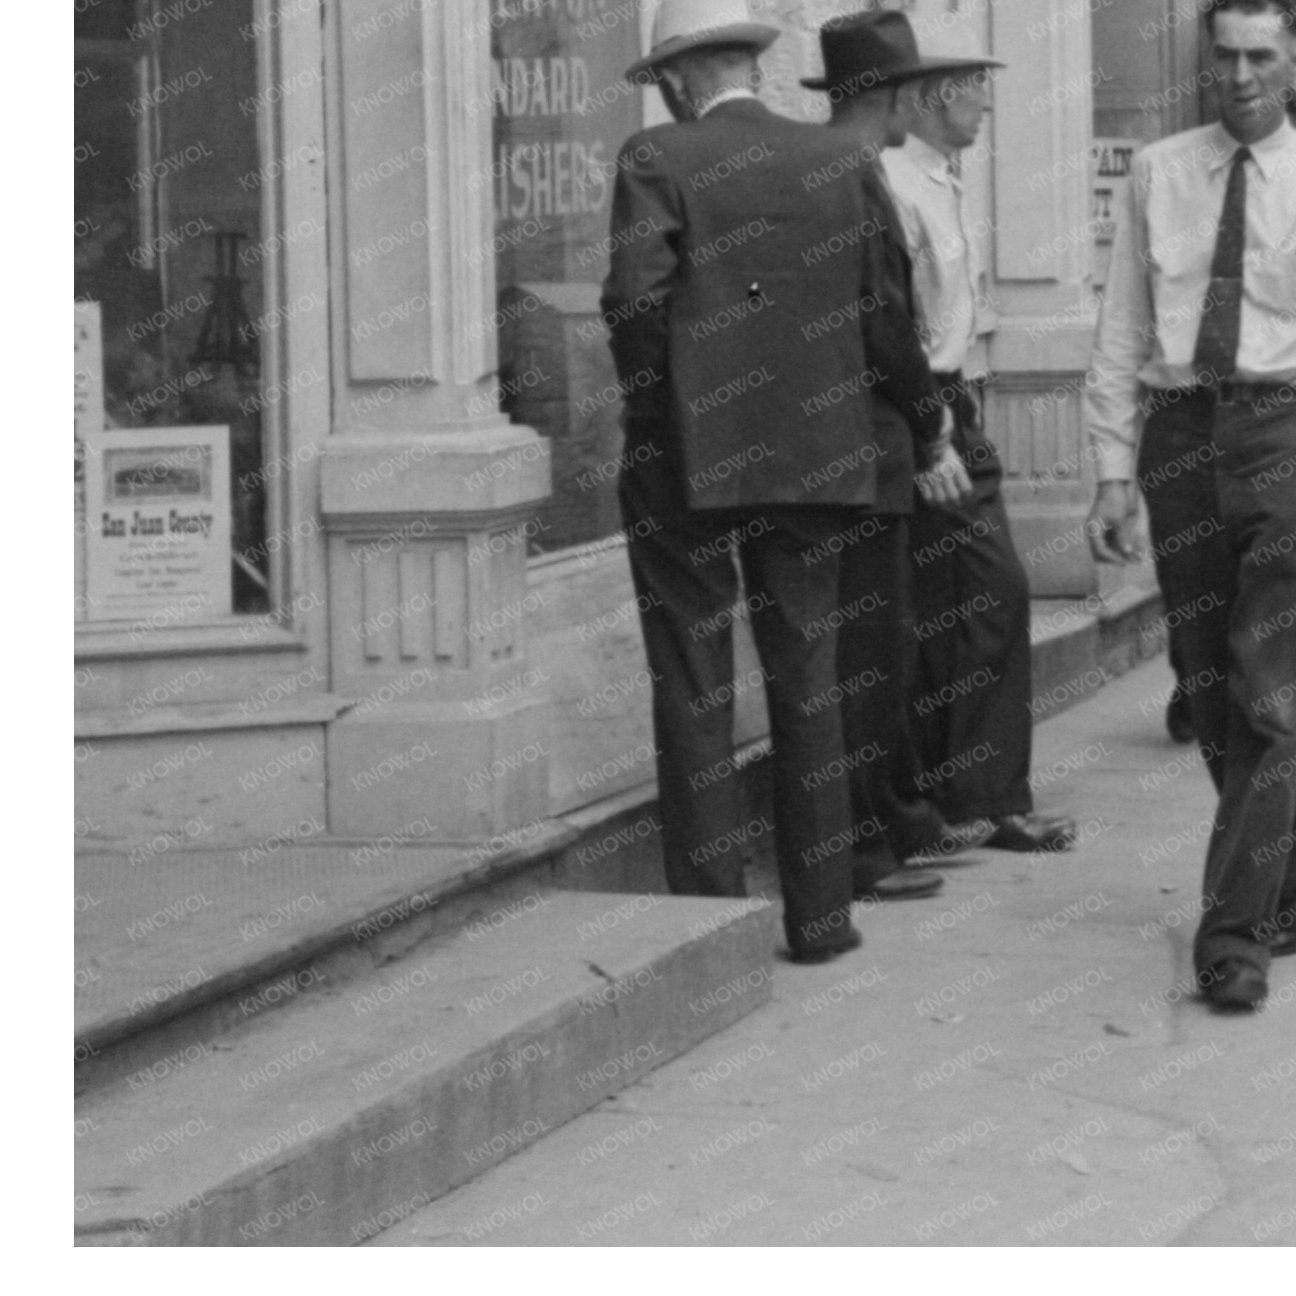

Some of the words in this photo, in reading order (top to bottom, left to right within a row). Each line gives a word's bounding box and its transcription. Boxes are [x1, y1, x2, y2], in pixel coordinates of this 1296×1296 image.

[101, 512, 127, 538] San
[130, 509, 164, 536] Juan
[168, 508, 213, 539] County
